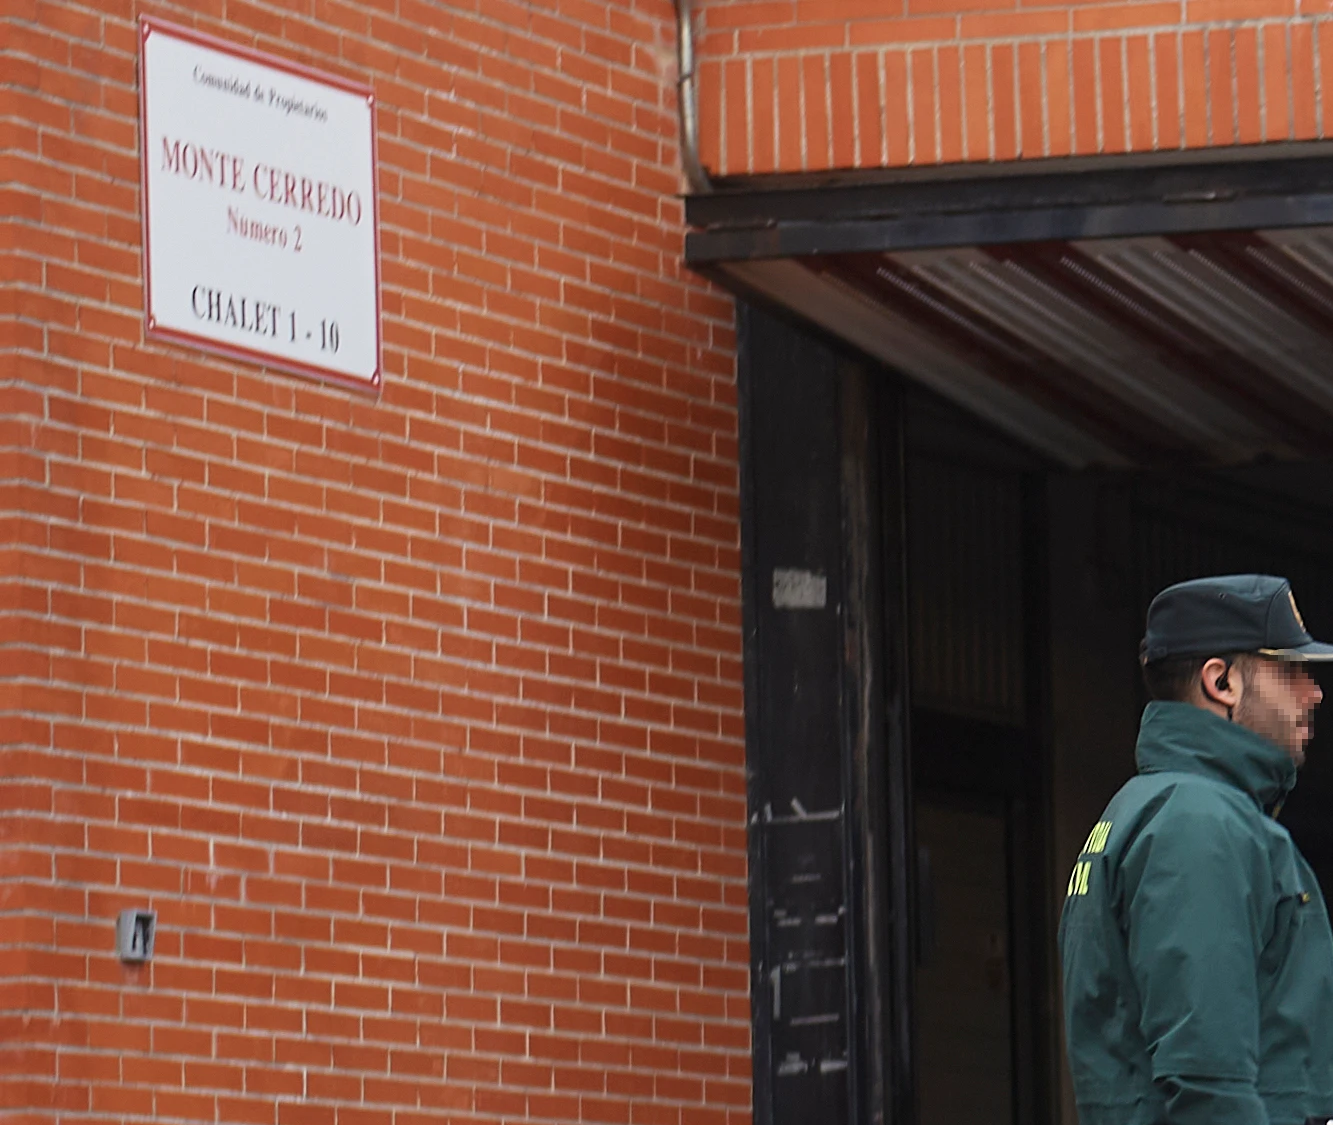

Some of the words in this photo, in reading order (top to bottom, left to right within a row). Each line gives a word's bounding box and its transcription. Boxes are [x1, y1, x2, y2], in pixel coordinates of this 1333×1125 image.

[193, 64, 251, 100] Comunidad
[161, 136, 245, 193] MONTE
[253, 162, 363, 227] CERREDO
[294, 228, 303, 252] 2
[191, 284, 281, 339] CHALET
[289, 311, 297, 343] 1
[320, 317, 340, 355] 10
